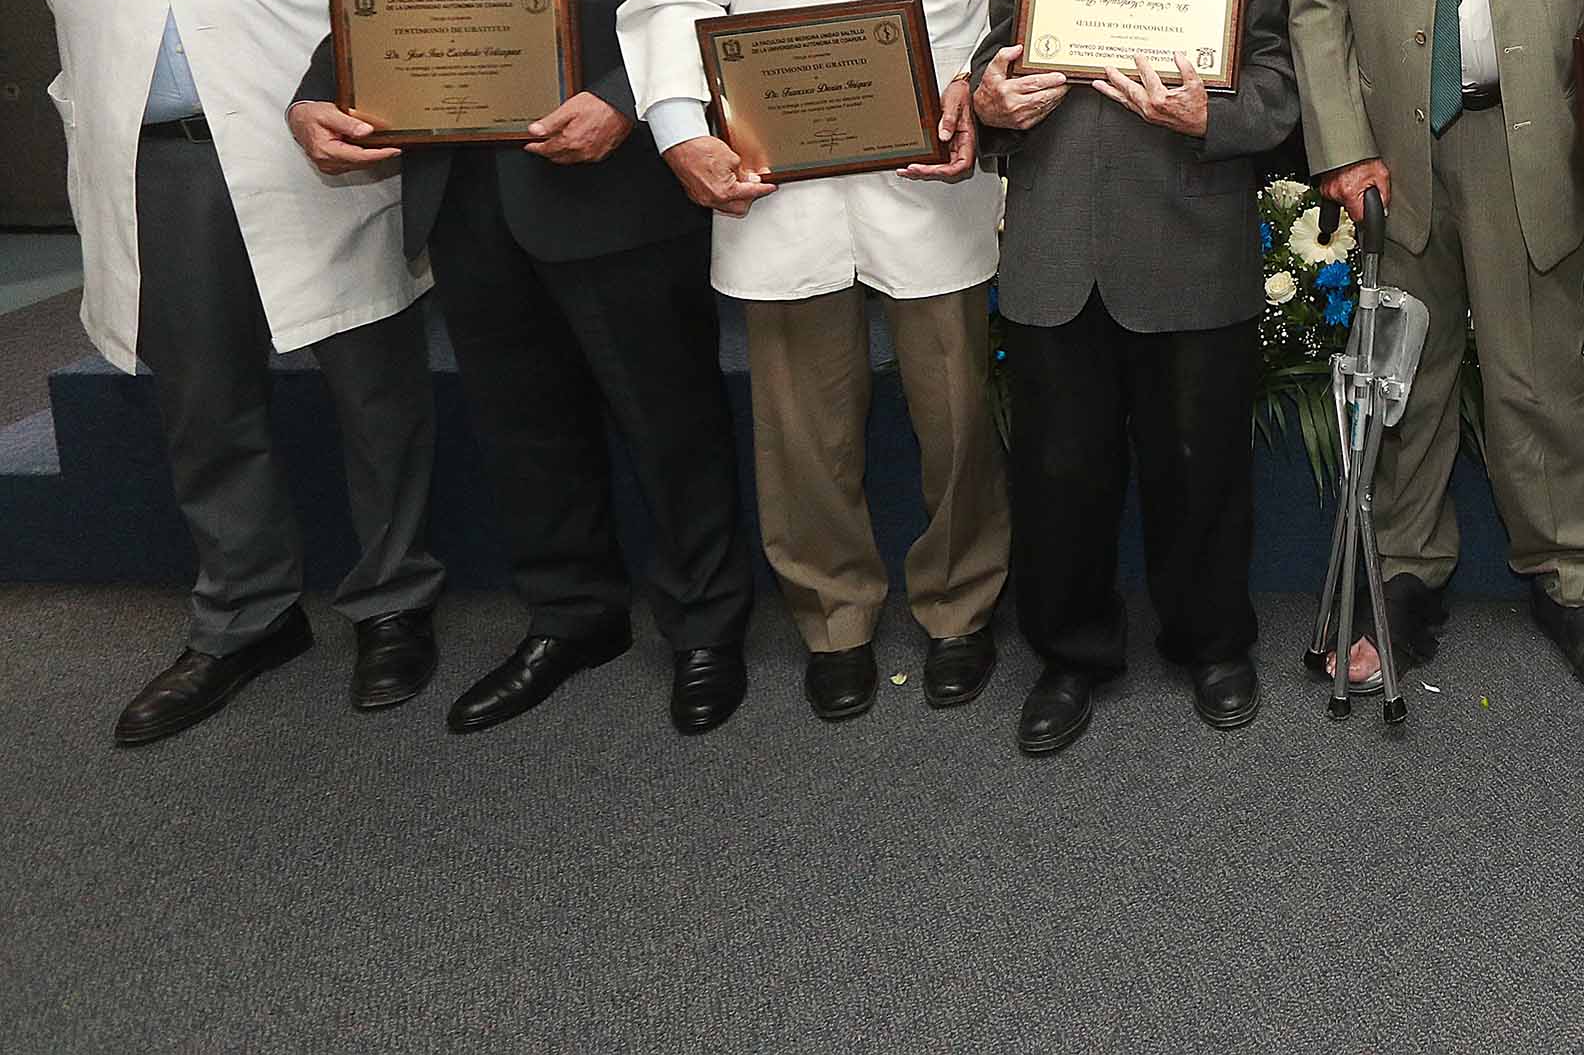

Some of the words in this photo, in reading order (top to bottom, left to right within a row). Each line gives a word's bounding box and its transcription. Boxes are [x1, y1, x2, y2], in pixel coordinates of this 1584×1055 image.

[760, 63, 812, 76] TESTIMONIO
[812, 63, 824, 71] DE
[825, 57, 868, 69] GRATITUD
